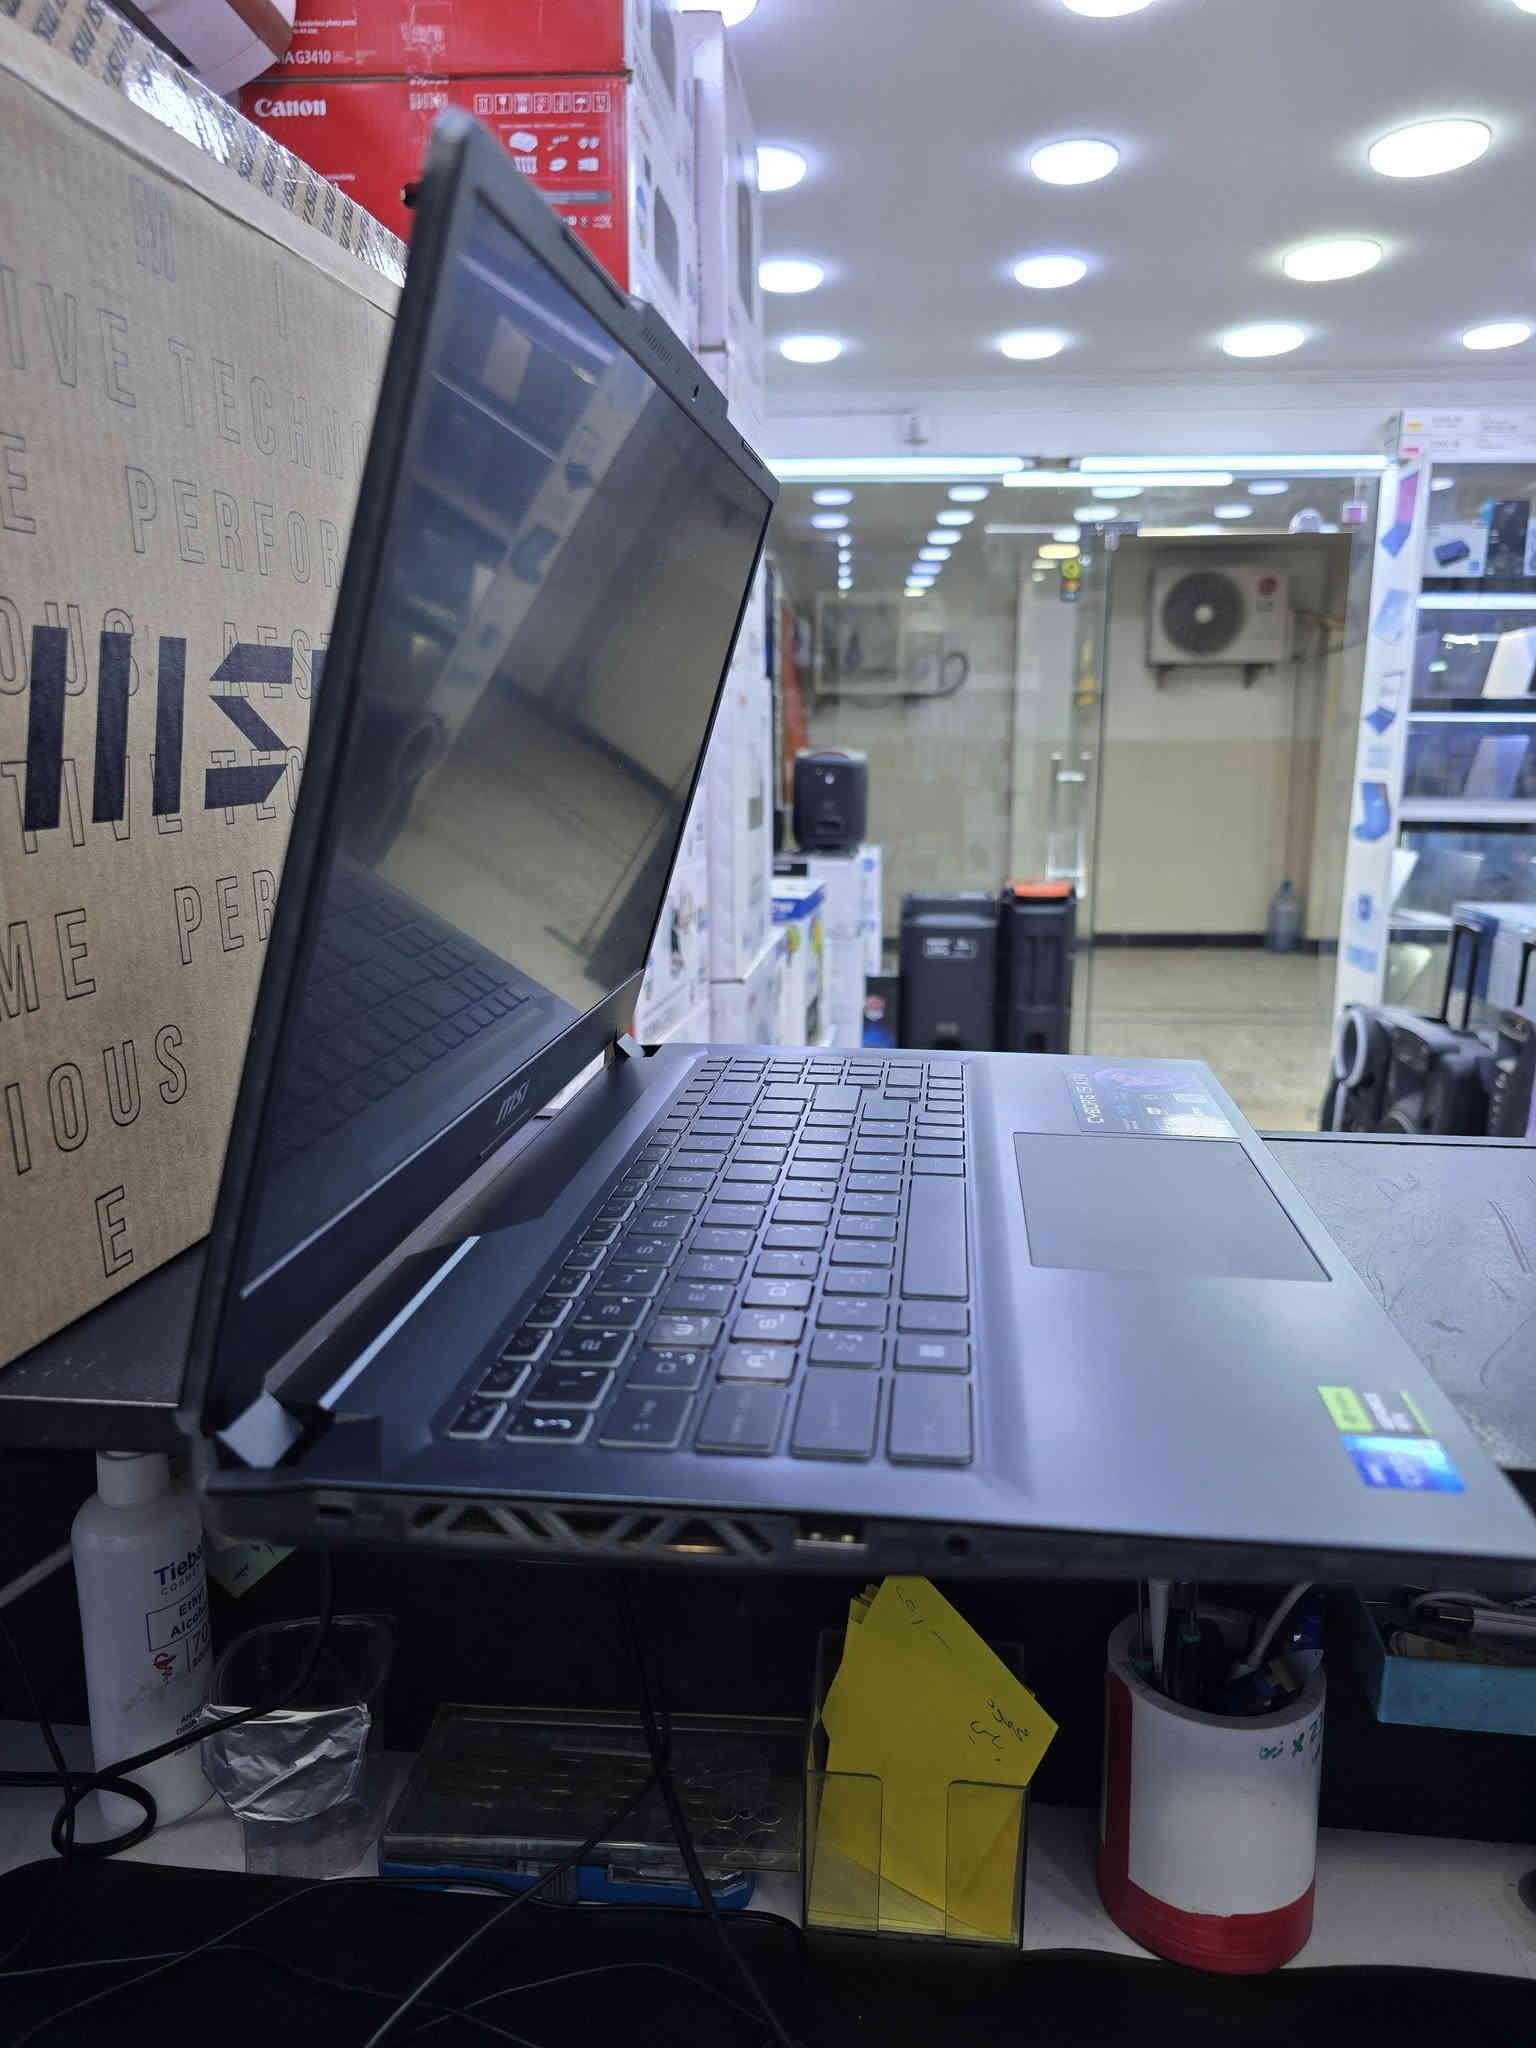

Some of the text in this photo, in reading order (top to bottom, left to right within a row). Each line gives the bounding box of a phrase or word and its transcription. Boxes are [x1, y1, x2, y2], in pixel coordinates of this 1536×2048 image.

[296, 50, 331, 65] G3410
[254, 97, 327, 117] Canon
[173, 868, 279, 966] PER
[4, 1024, 188, 1176] IOUS
[95, 1185, 134, 1278] E
[152, 1543, 202, 1586] Tieb
